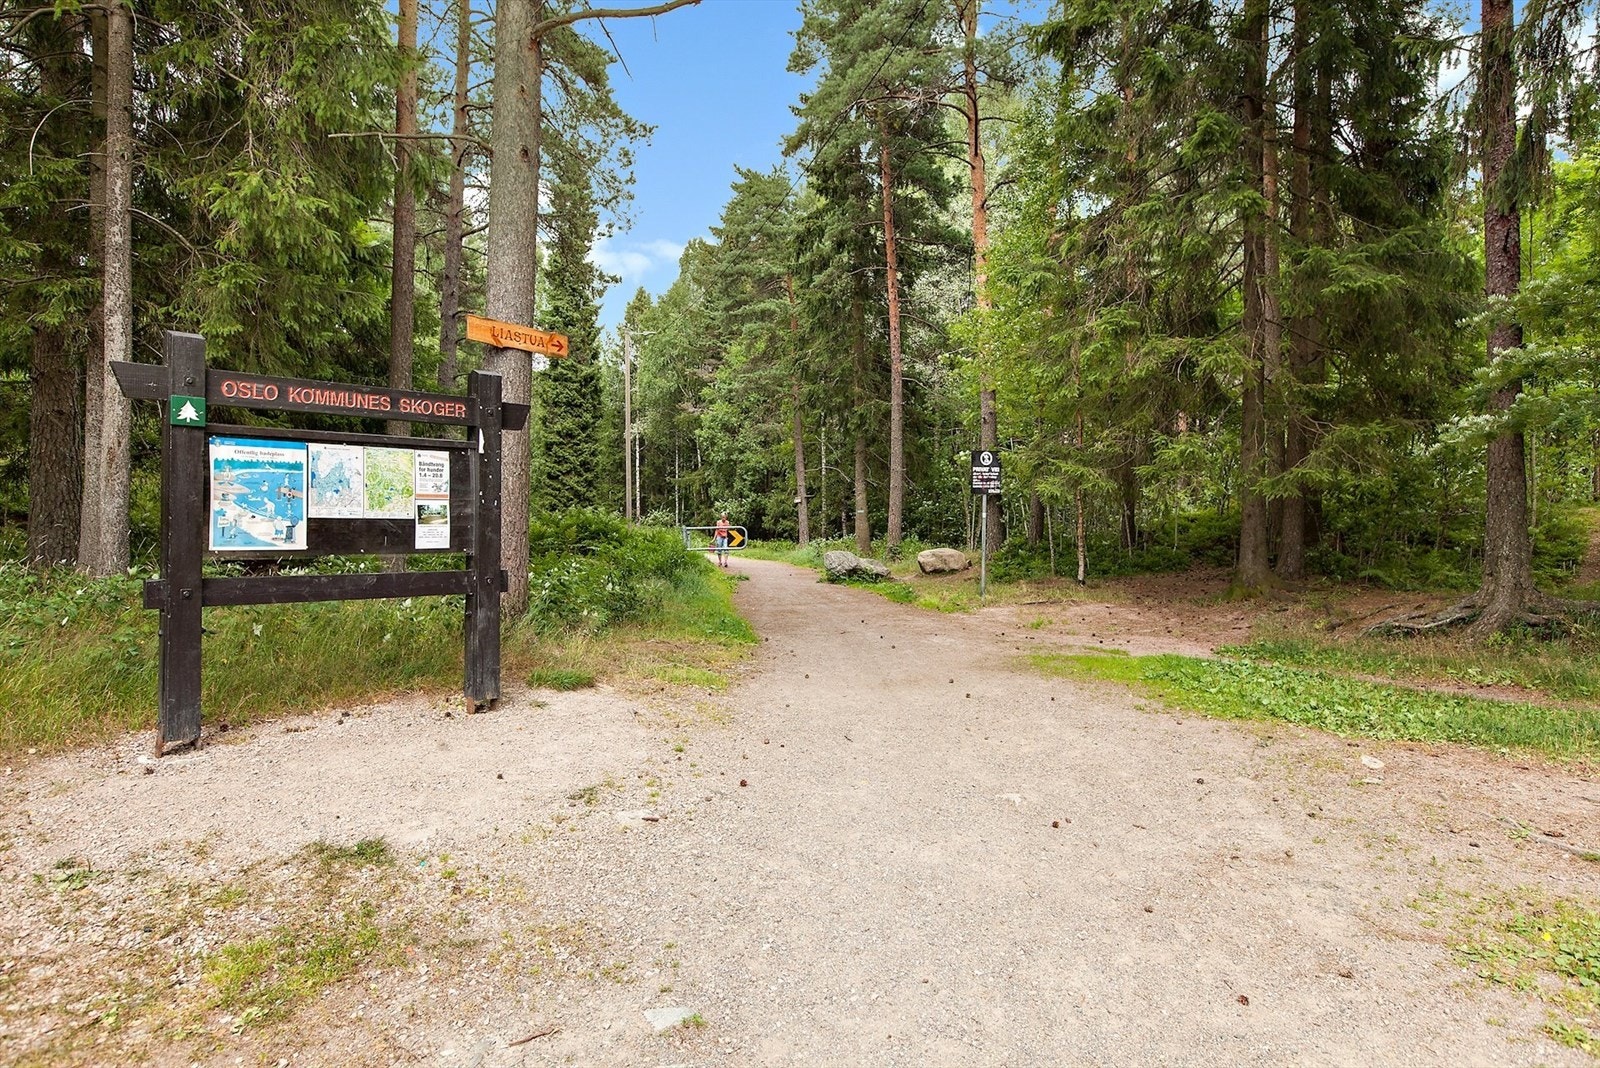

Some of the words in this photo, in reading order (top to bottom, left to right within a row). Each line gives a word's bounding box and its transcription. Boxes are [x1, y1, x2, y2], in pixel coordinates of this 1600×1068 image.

[492, 326, 545, 348] LIASTUA
[221, 380, 279, 401] OSLO
[288, 386, 391, 411] KOMMUNES
[400, 398, 466, 418] SKOGER
